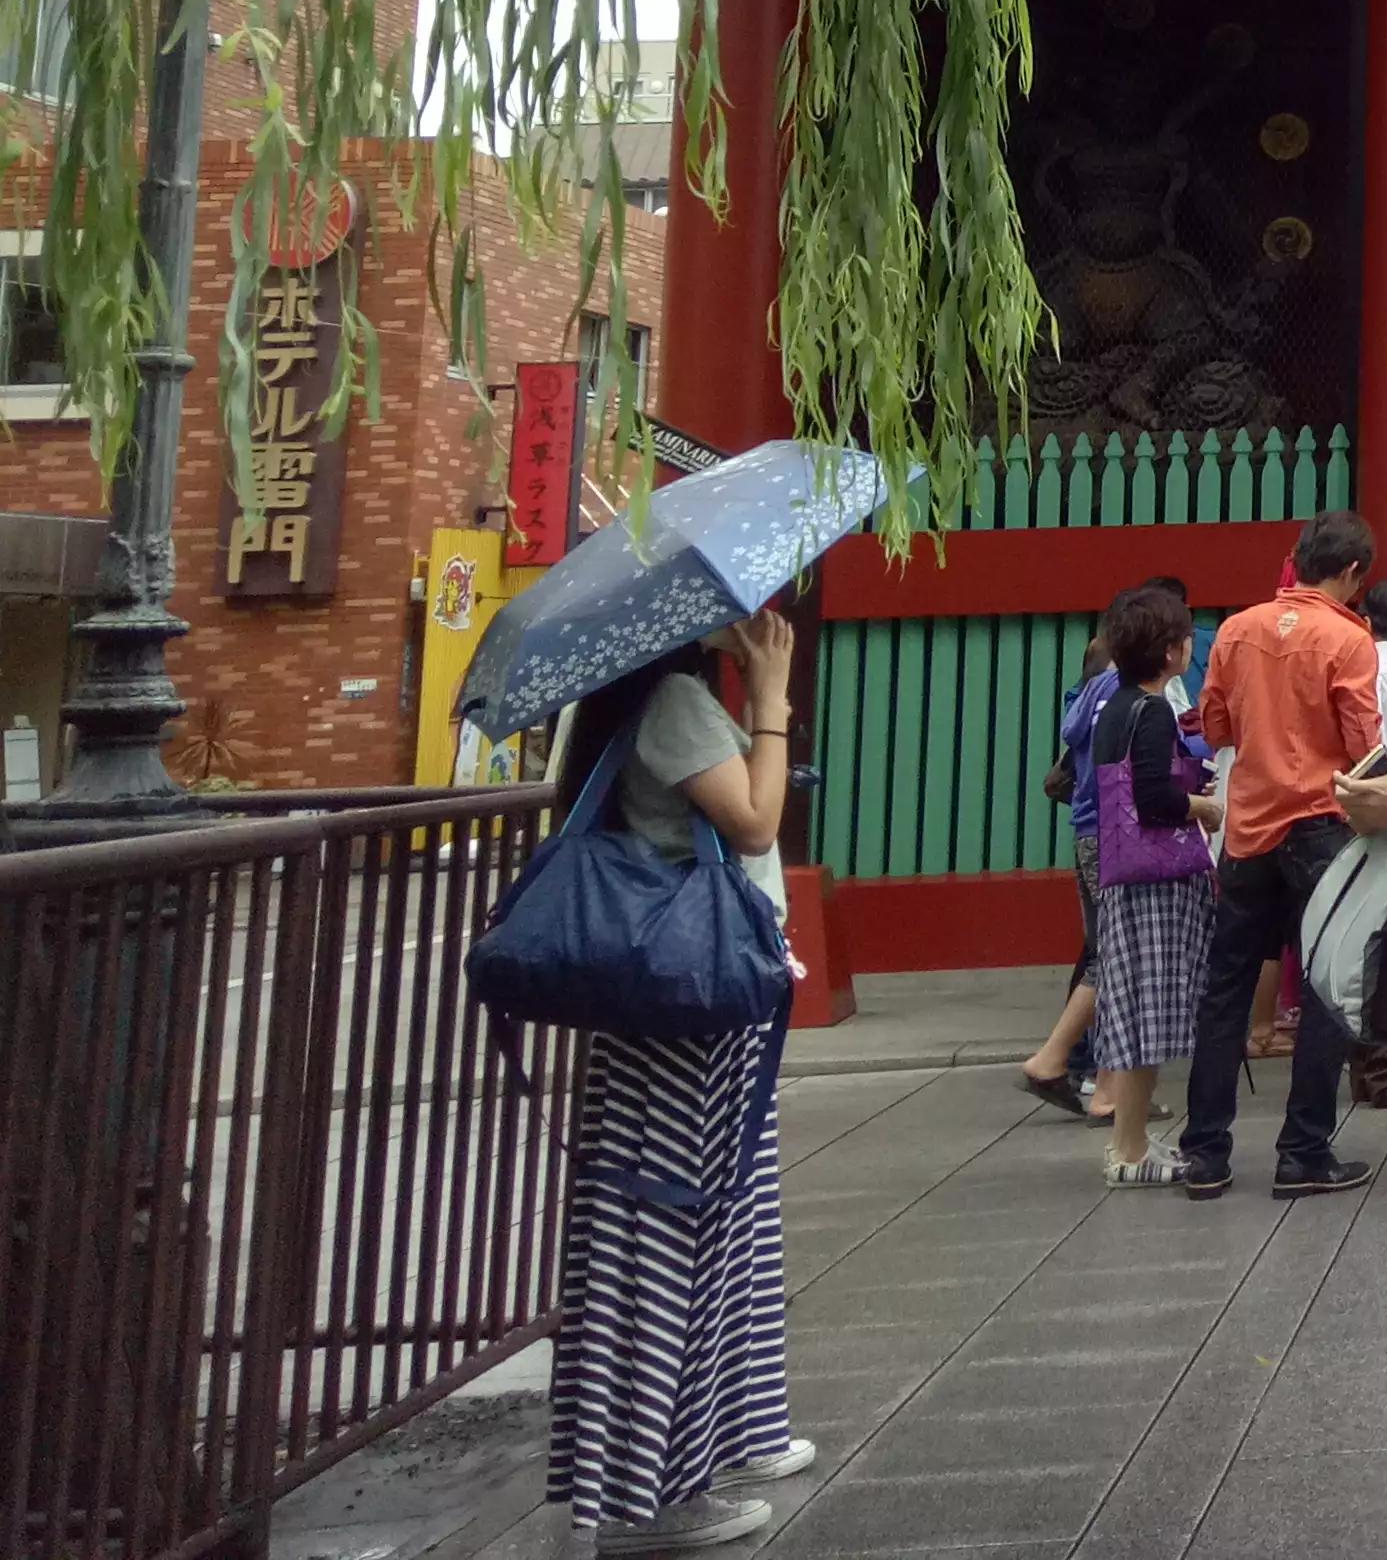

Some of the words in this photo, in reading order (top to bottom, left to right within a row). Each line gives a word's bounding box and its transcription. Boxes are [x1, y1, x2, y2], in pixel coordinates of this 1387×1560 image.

[227, 276, 320, 585] ホテル雷門
